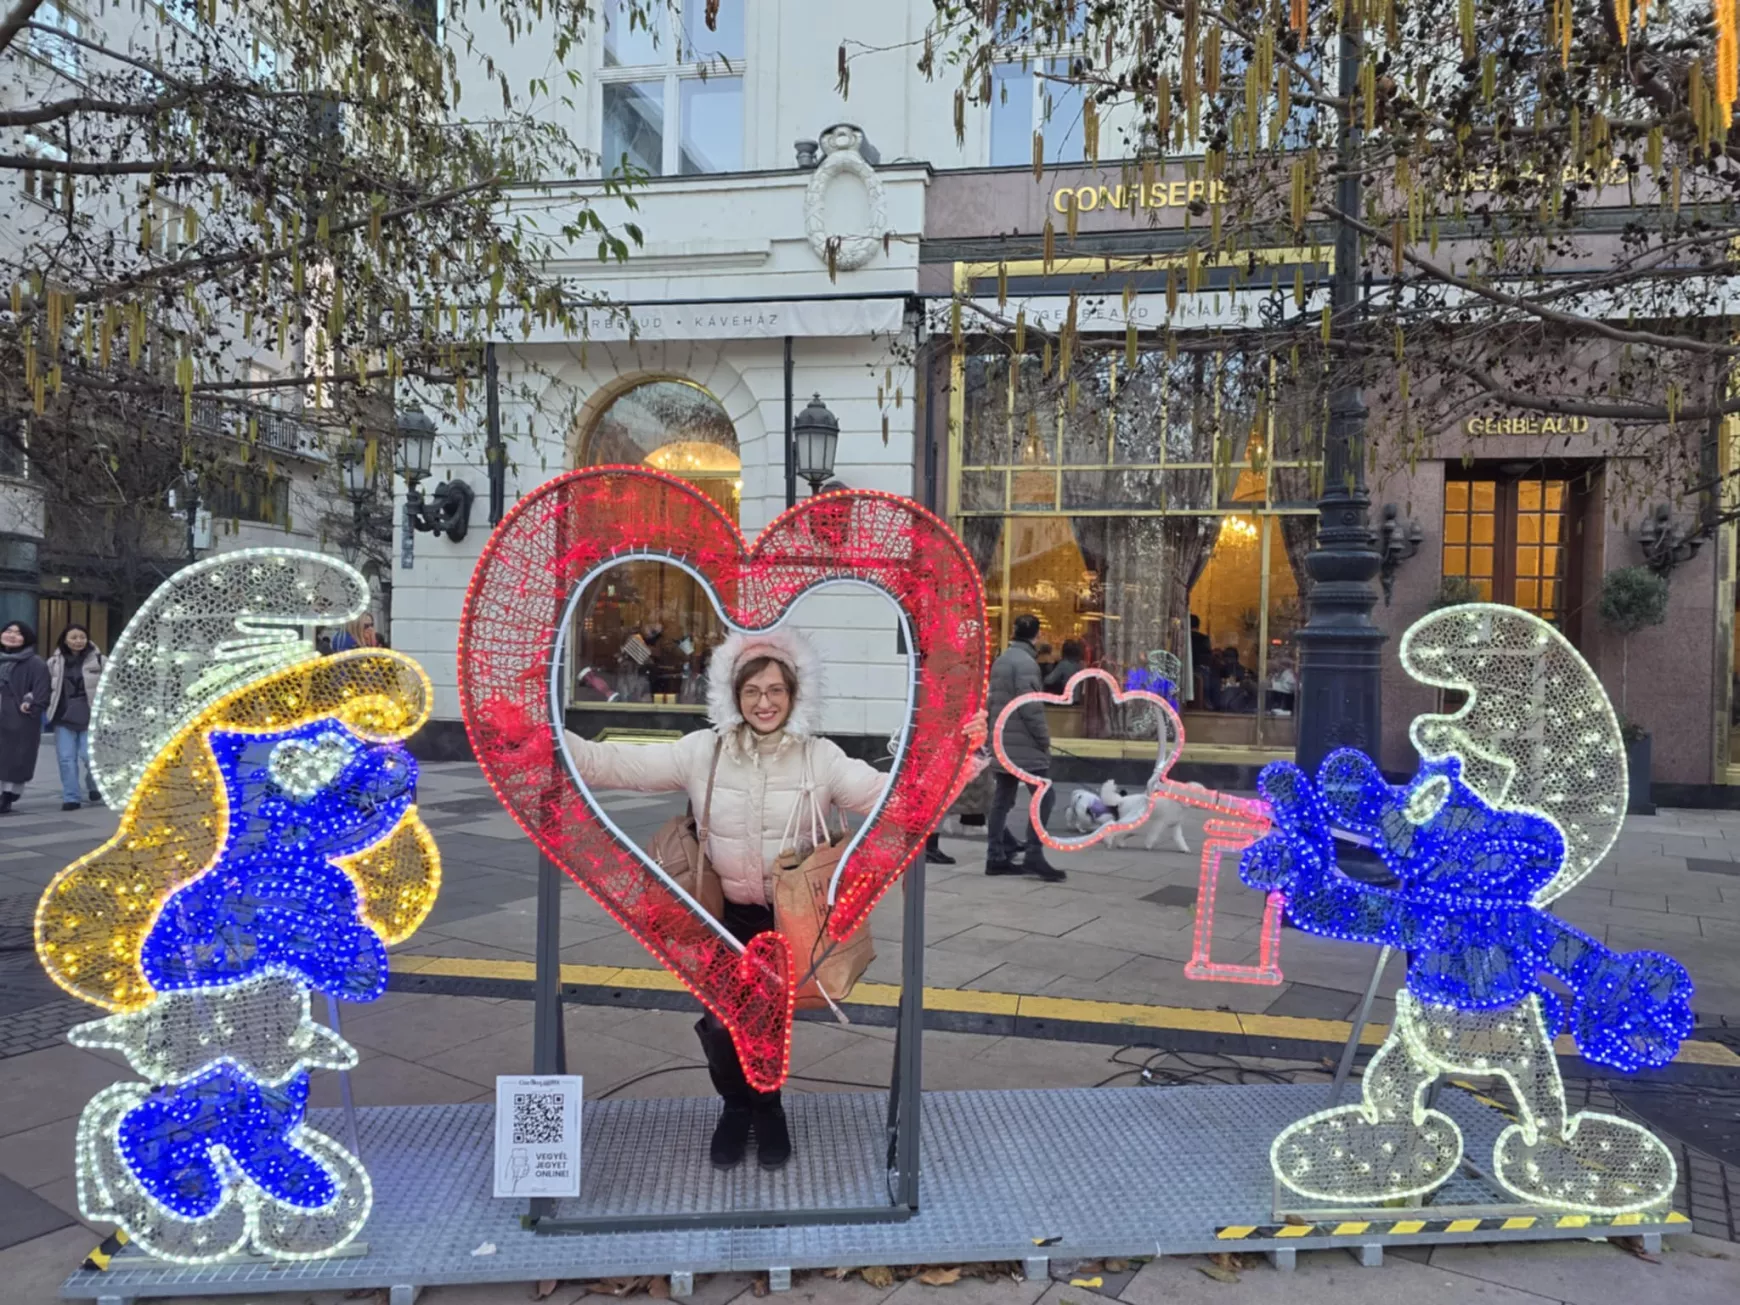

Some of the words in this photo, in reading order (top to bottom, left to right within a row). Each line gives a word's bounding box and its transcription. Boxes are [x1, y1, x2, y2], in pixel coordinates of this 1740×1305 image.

[1467, 416, 1589, 435] GERBEAUD
[535, 1151, 568, 1161] VEGYÉL
[535, 1161, 567, 1169] JEGYET
[535, 1170, 569, 1178] ONLINE!
